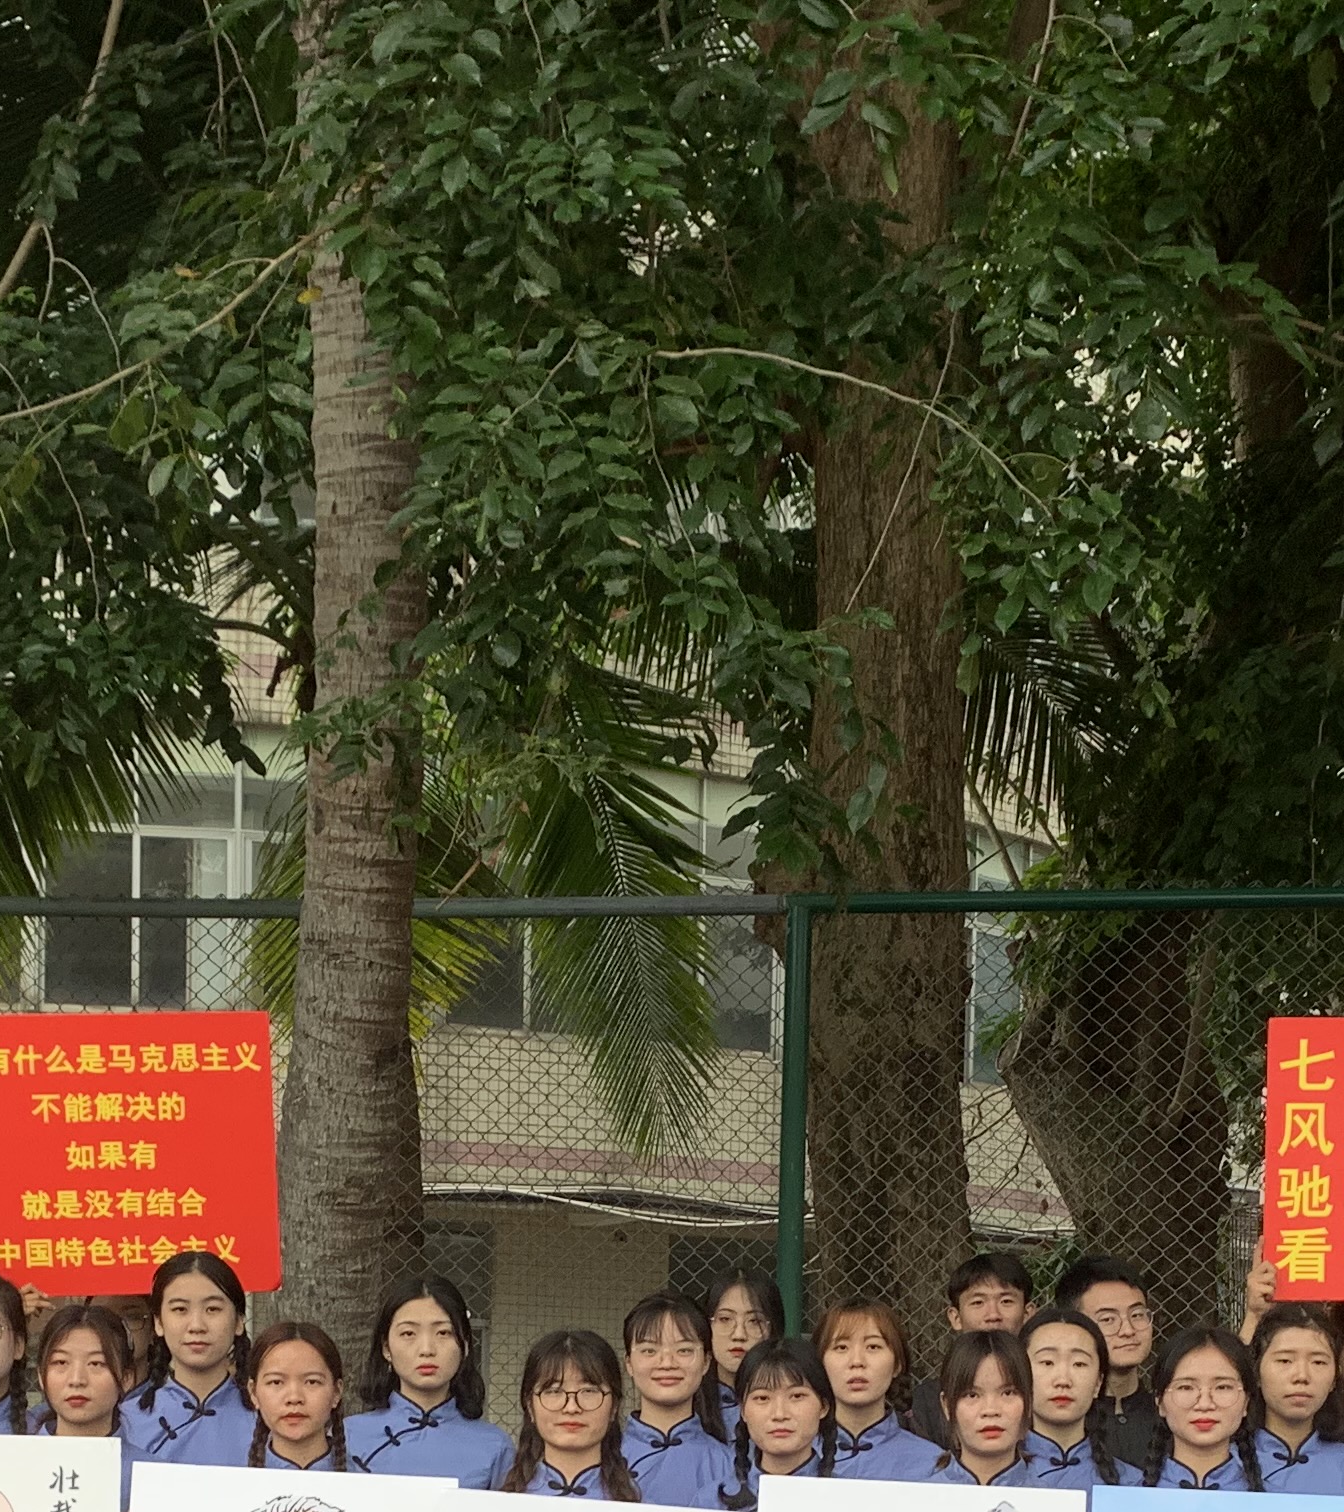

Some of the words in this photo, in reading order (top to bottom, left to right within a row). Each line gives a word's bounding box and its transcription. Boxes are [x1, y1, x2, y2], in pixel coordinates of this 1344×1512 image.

[31, 1092, 187, 1123] 不能解决的
[65, 1140, 158, 1170] 如果有
[20, 1187, 207, 1220] 就是没有结合
